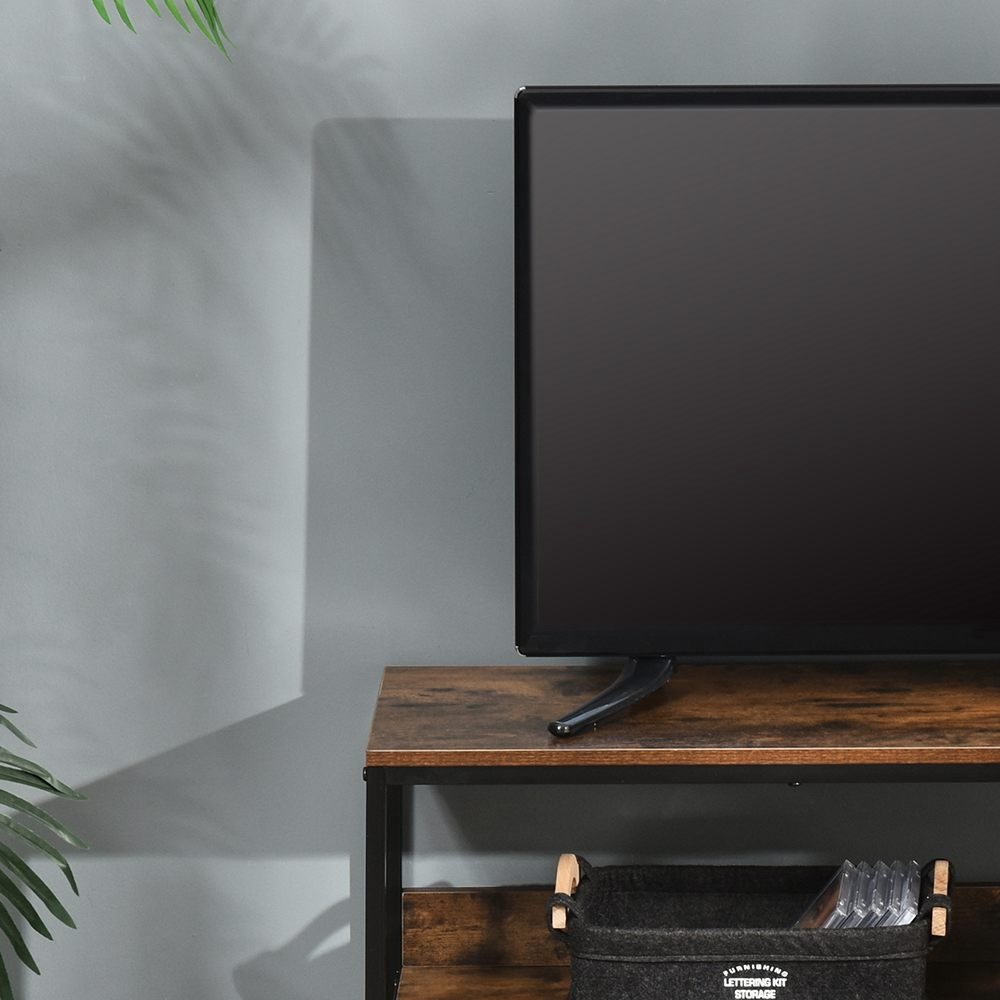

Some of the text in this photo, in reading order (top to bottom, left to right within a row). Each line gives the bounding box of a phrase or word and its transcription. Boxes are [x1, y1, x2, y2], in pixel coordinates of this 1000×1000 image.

[723, 977, 788, 988] LETTERING KIT
[734, 989, 776, 999] STORAGE
